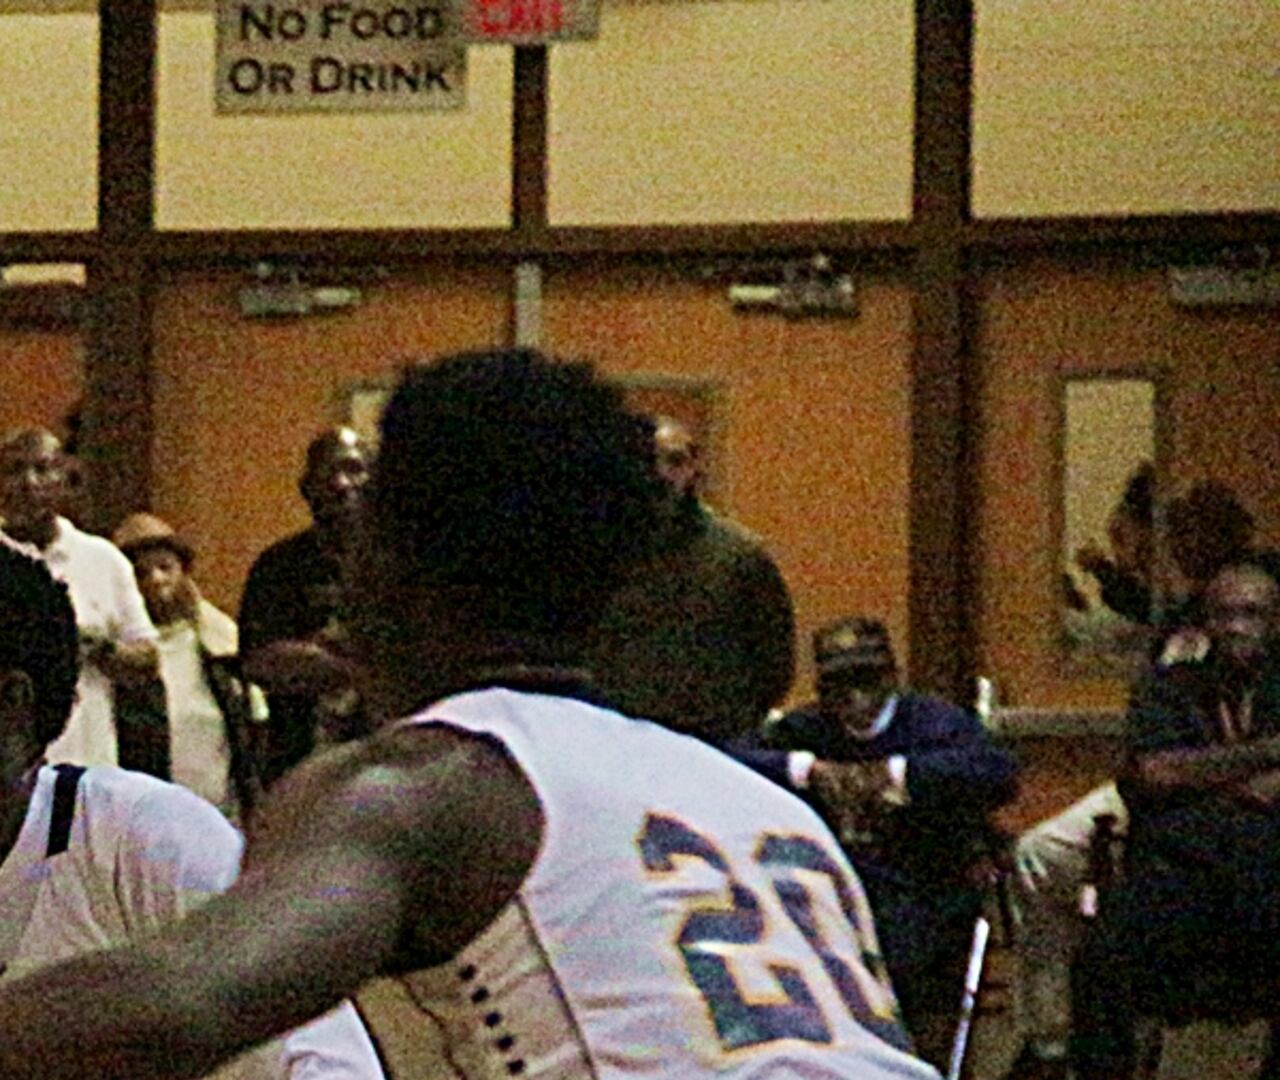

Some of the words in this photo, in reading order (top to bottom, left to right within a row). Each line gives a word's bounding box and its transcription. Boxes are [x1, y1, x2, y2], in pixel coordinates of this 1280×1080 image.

[240, 4, 307, 40] NO
[320, 5, 441, 39] FOOD
[228, 57, 295, 94] OR
[310, 57, 451, 93] DRINK
